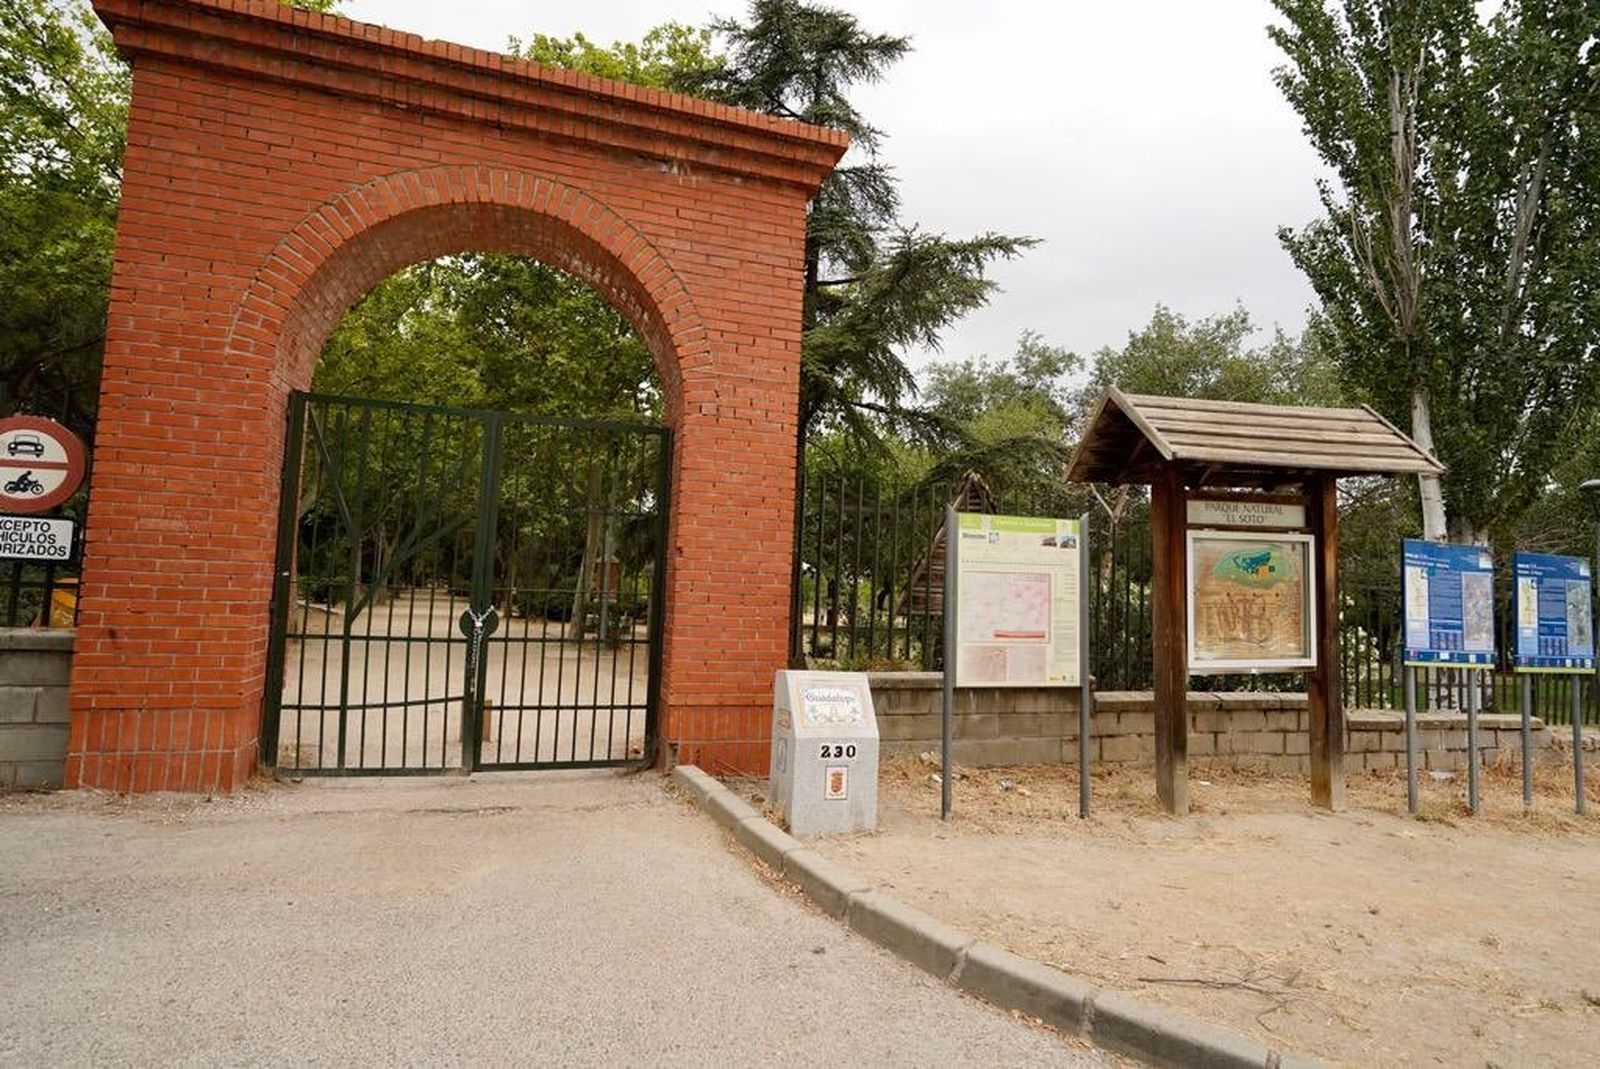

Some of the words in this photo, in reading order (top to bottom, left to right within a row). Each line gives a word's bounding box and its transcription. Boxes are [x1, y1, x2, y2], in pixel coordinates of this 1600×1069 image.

[1204, 502, 1239, 513] PARQUE
[1243, 504, 1285, 515] NATURAL
[0, 544, 66, 557] RIZADOS
[820, 745, 857, 758] 230
